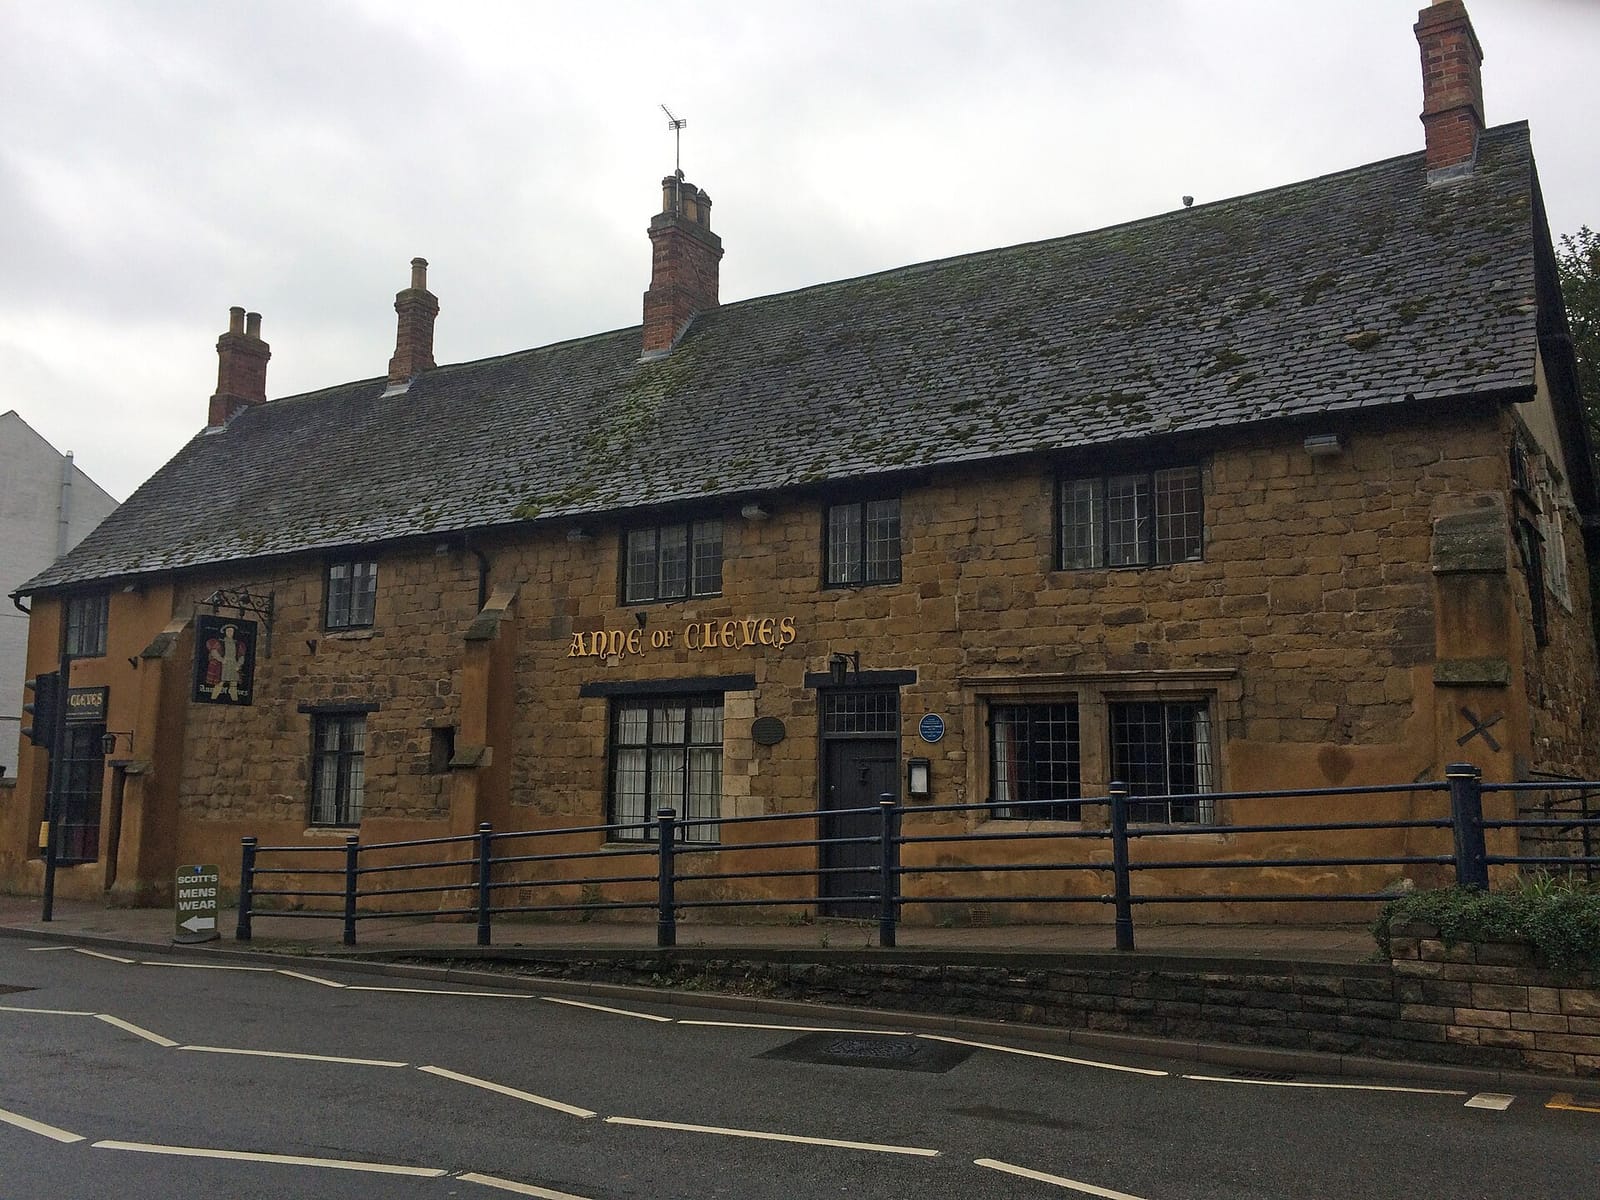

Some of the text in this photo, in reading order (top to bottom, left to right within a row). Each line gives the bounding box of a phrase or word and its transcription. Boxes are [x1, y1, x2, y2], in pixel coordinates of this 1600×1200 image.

[567, 615, 797, 660] ANNE OF CLEVES
[70, 693, 102, 707] CLEVES
[177, 874, 218, 884] SCOTT'S
[179, 887, 217, 899] MENS
[178, 900, 216, 911] WEAR
